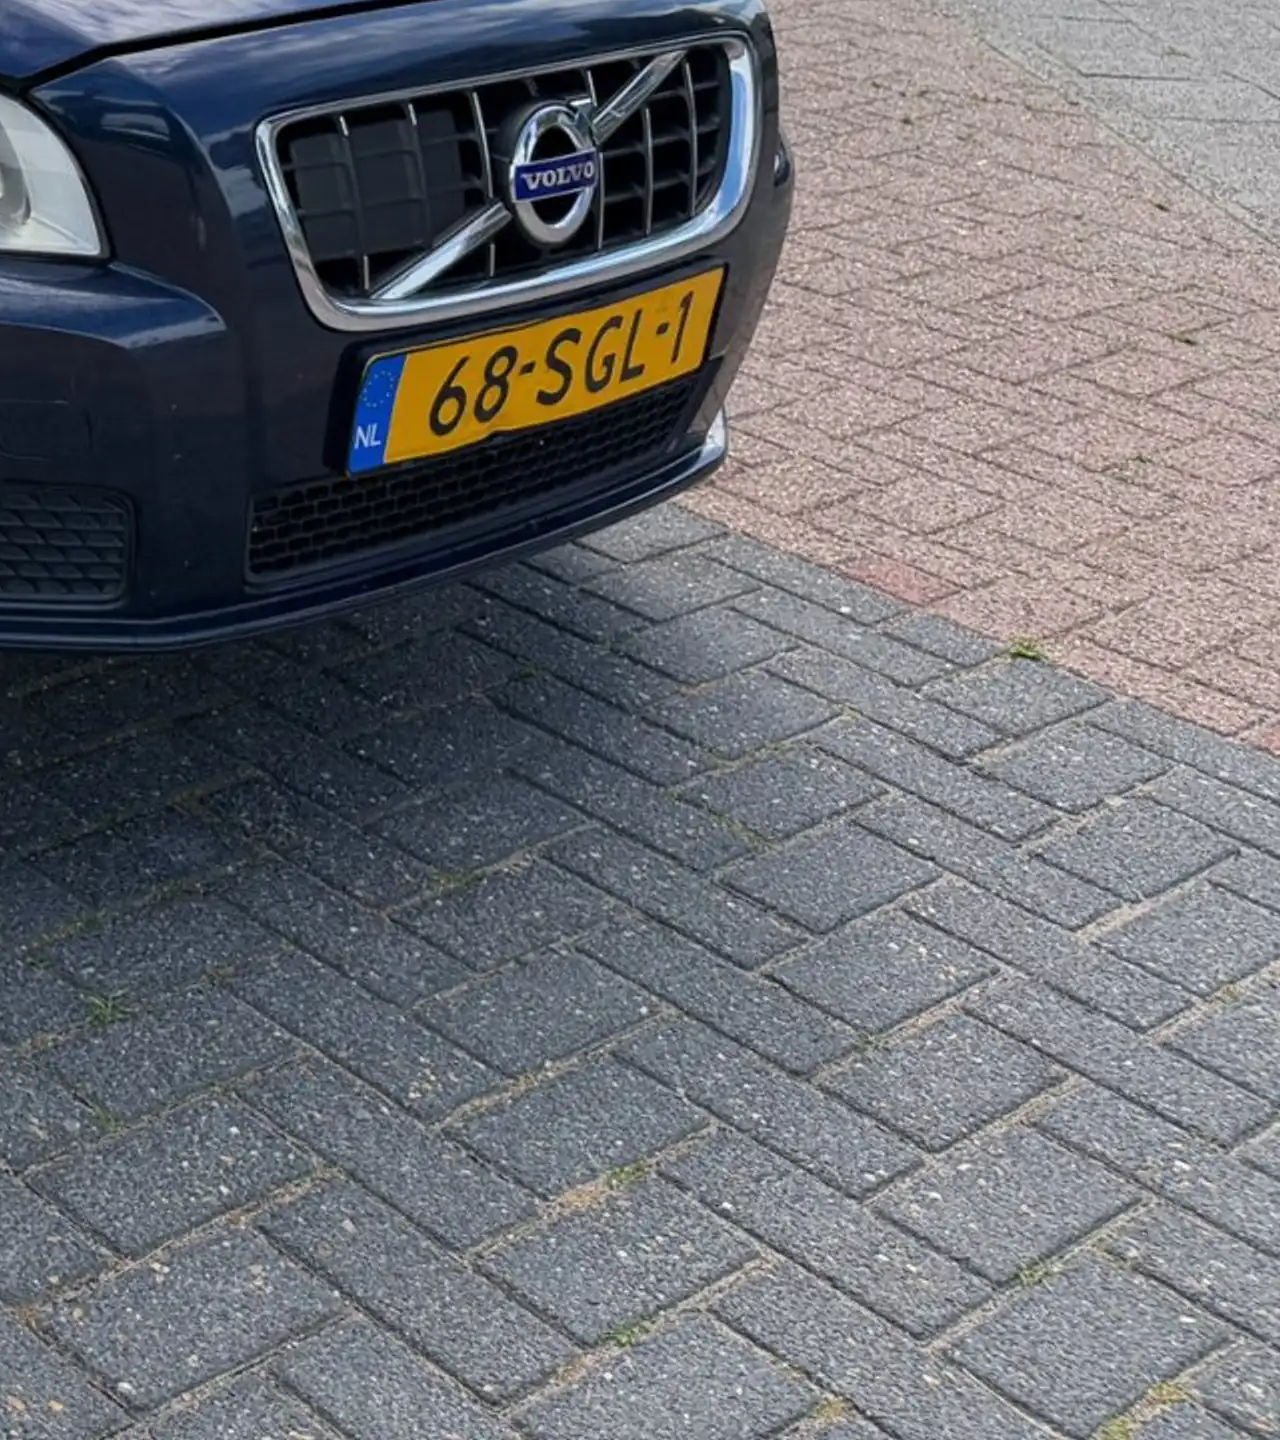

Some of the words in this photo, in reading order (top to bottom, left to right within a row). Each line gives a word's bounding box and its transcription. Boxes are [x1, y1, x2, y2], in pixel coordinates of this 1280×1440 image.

[520, 162, 594, 191] VOLVO
[354, 424, 381, 449] NL
[428, 290, 694, 436] 68-SGL-1
